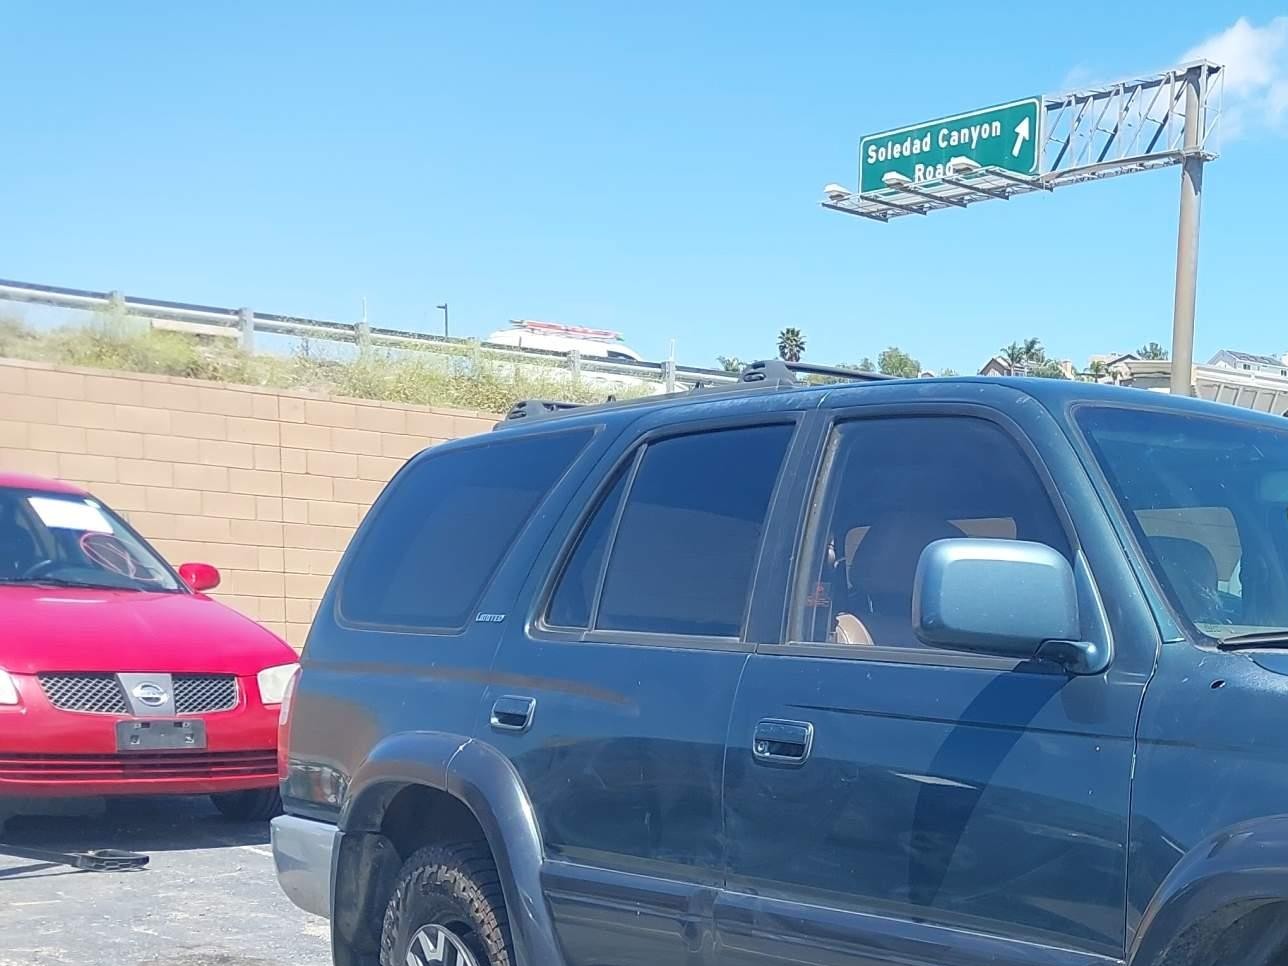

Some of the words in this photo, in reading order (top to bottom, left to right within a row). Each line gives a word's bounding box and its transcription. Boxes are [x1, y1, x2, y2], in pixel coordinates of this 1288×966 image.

[867, 132, 931, 164] Soledad
[938, 120, 1001, 150] Canyon
[914, 162, 954, 184] Road
